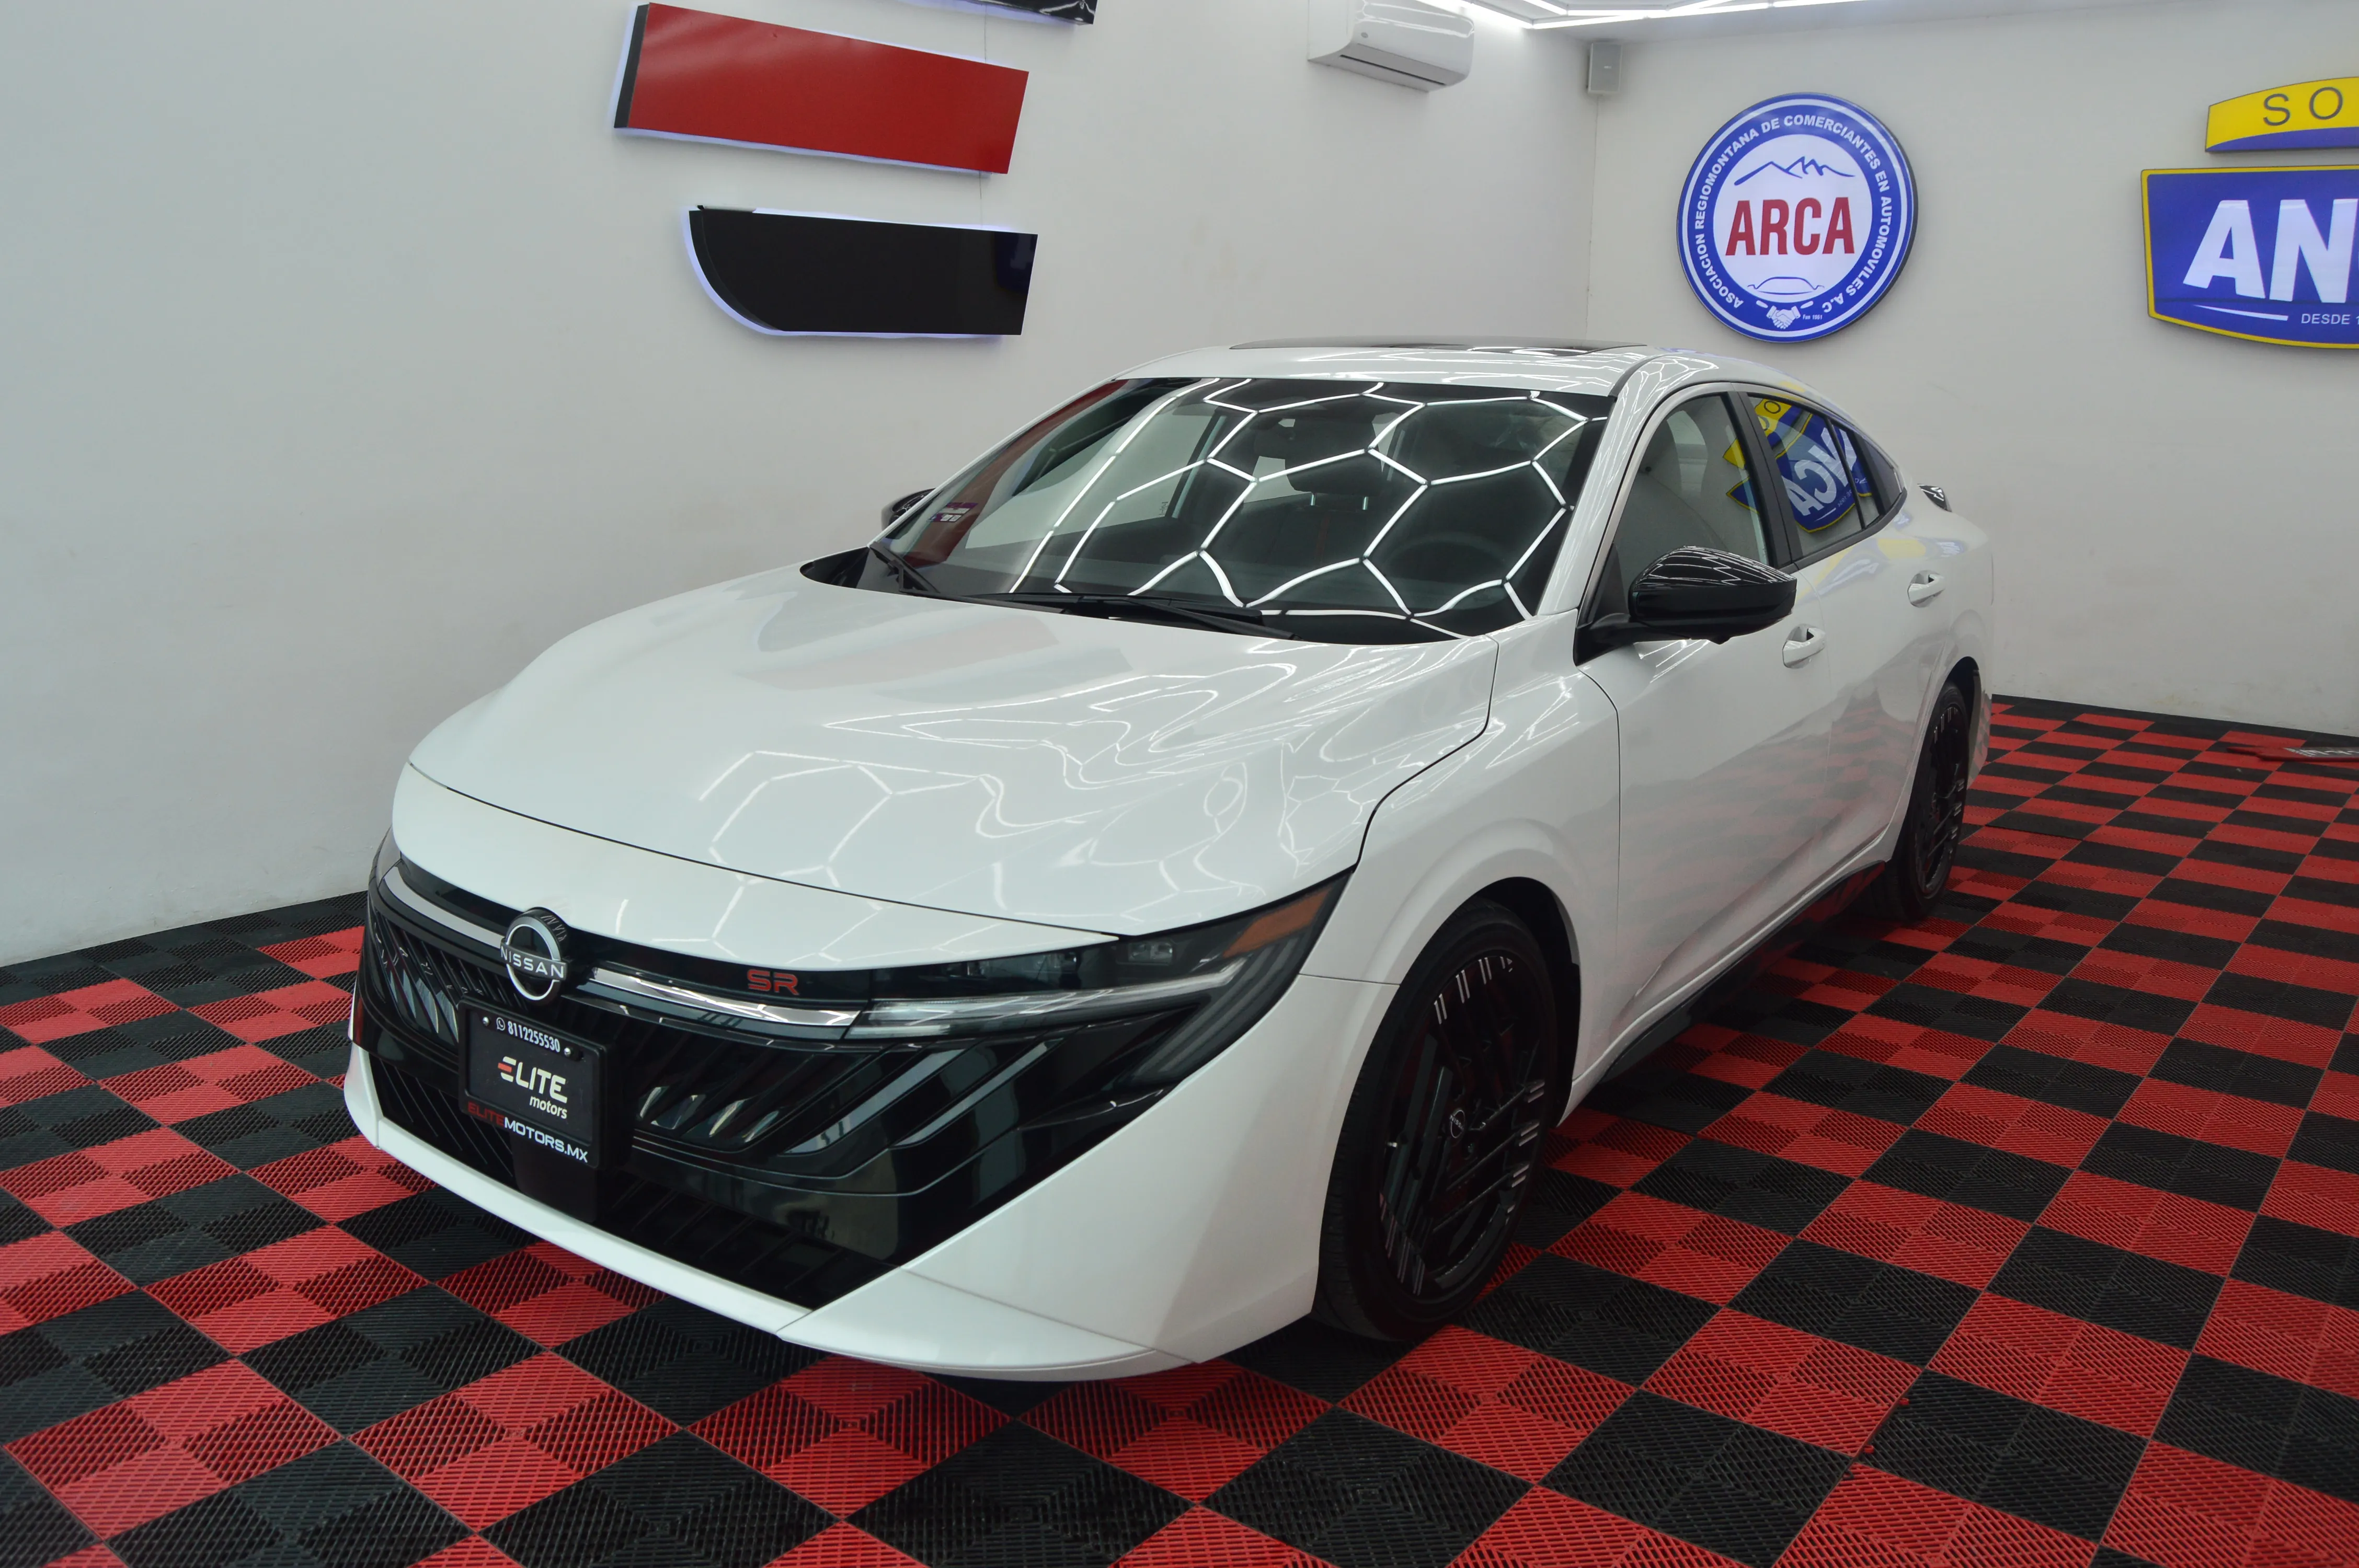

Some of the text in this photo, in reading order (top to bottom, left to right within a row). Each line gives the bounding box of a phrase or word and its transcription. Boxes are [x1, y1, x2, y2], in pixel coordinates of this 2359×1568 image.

[2263, 86, 2344, 126] SO
[1760, 118, 1780, 134] DE
[1783, 114, 1881, 170] COMERCIANTES
[1694, 128, 1759, 229] REGIOMONTANA
[1875, 170, 1890, 192] EN
[1725, 197, 1855, 256] ARCA
[1845, 196, 1892, 297] AUTOMOVILES
[2182, 198, 2359, 304] AN
[1695, 233, 1744, 308] ASOCIACION
[2301, 313, 2351, 325] DESDE
[500, 946, 564, 978] NISSAN
[747, 969, 800, 996] SR
[507, 1020, 561, 1053] 8112255530
[498, 1056, 568, 1104] ELITE
[529, 1096, 568, 1120] motors
[1449, 1114, 1464, 1132] NISS
